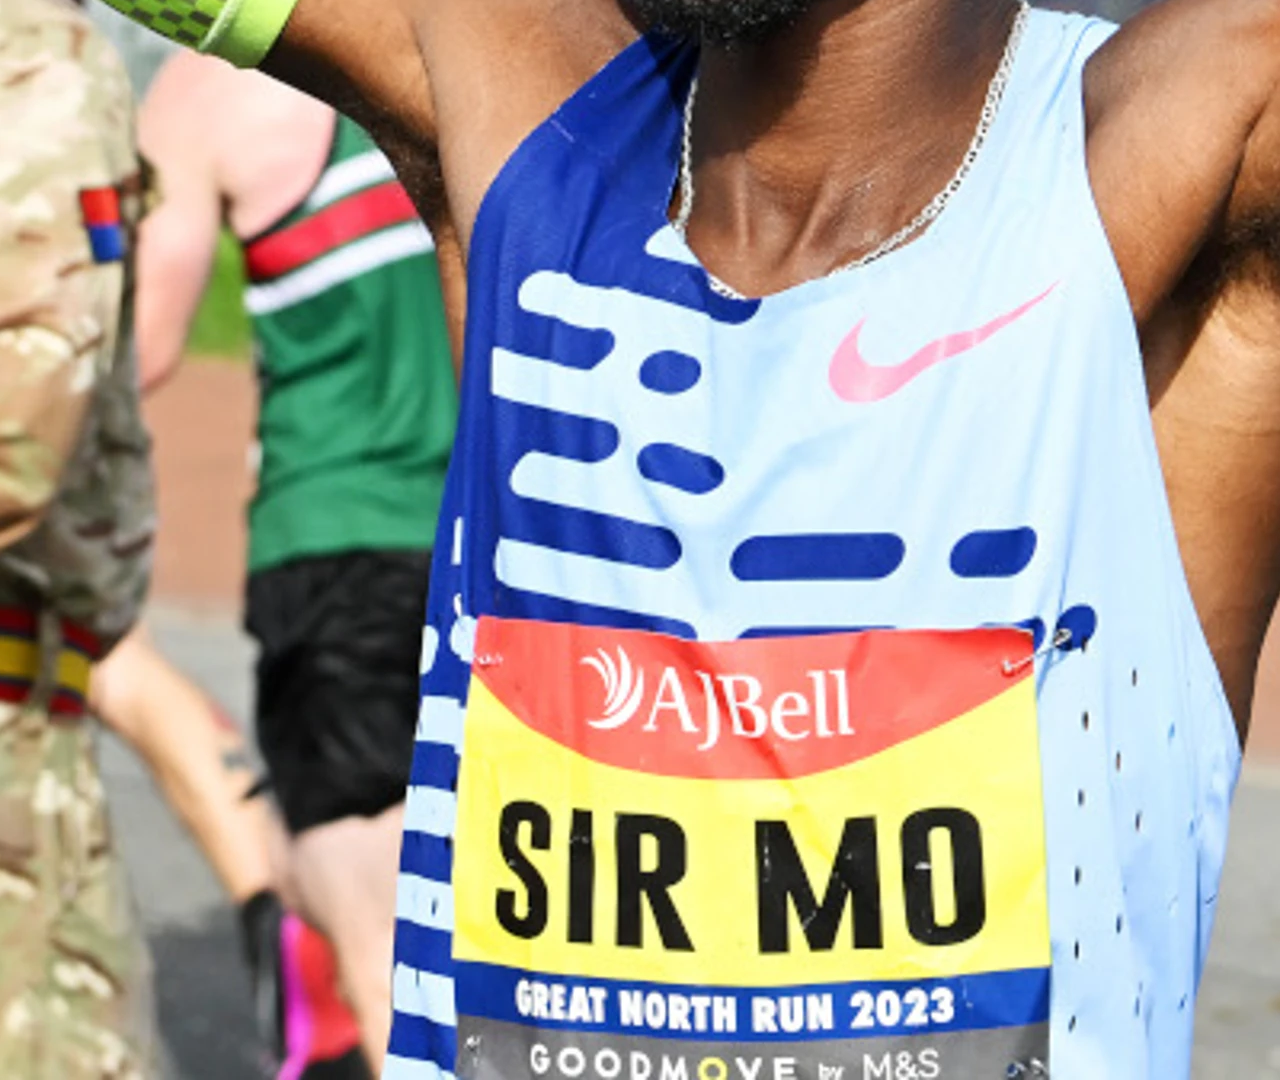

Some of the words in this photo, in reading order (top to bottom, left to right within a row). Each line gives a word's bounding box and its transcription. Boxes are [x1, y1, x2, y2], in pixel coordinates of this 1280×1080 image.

[495, 800, 696, 953] SIR
[754, 806, 987, 955] MO
[516, 979, 609, 1022] GREAT
[618, 990, 738, 1033] NORTH
[751, 993, 835, 1033] RUN
[849, 985, 956, 1030] 2023
[530, 1043, 798, 1080] GOODMOVE
[863, 1048, 941, 1080] M&S
